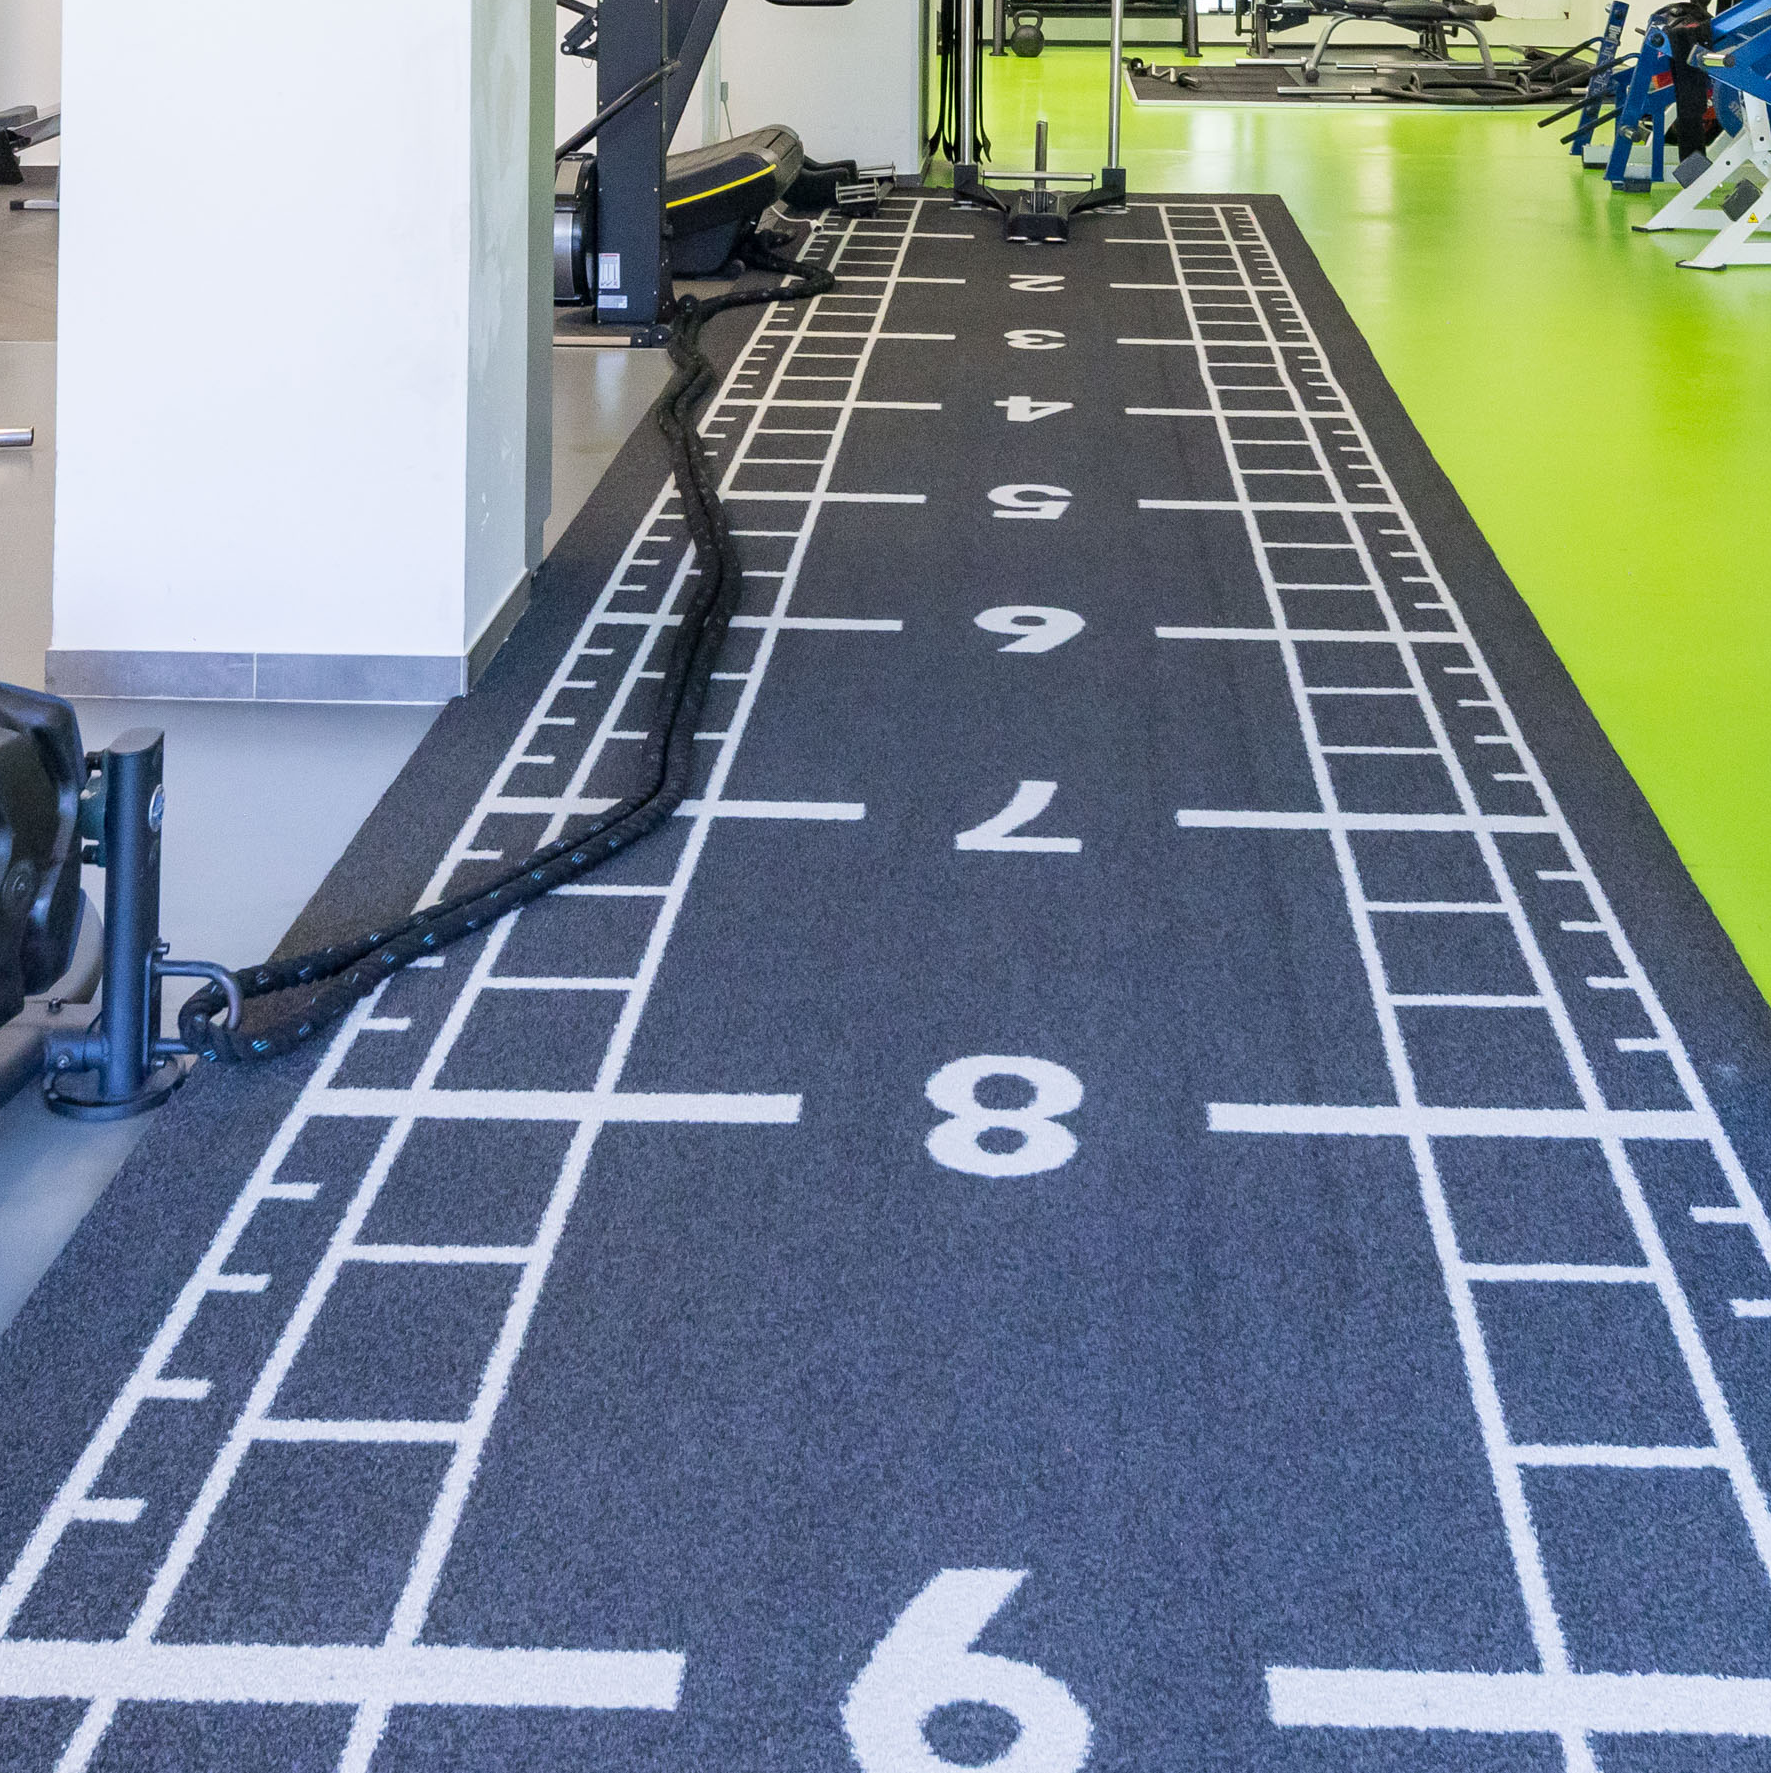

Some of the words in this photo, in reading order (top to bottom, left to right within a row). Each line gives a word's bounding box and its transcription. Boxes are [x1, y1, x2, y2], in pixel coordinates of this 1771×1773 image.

[1008, 273, 1065, 292] 2
[1003, 329, 1067, 351] 3
[994, 395, 1074, 423] 4
[987, 483, 1074, 520] 5
[973, 605, 1085, 654] 6
[955, 780, 1082, 853] 7
[924, 1054, 1084, 1178] 8
